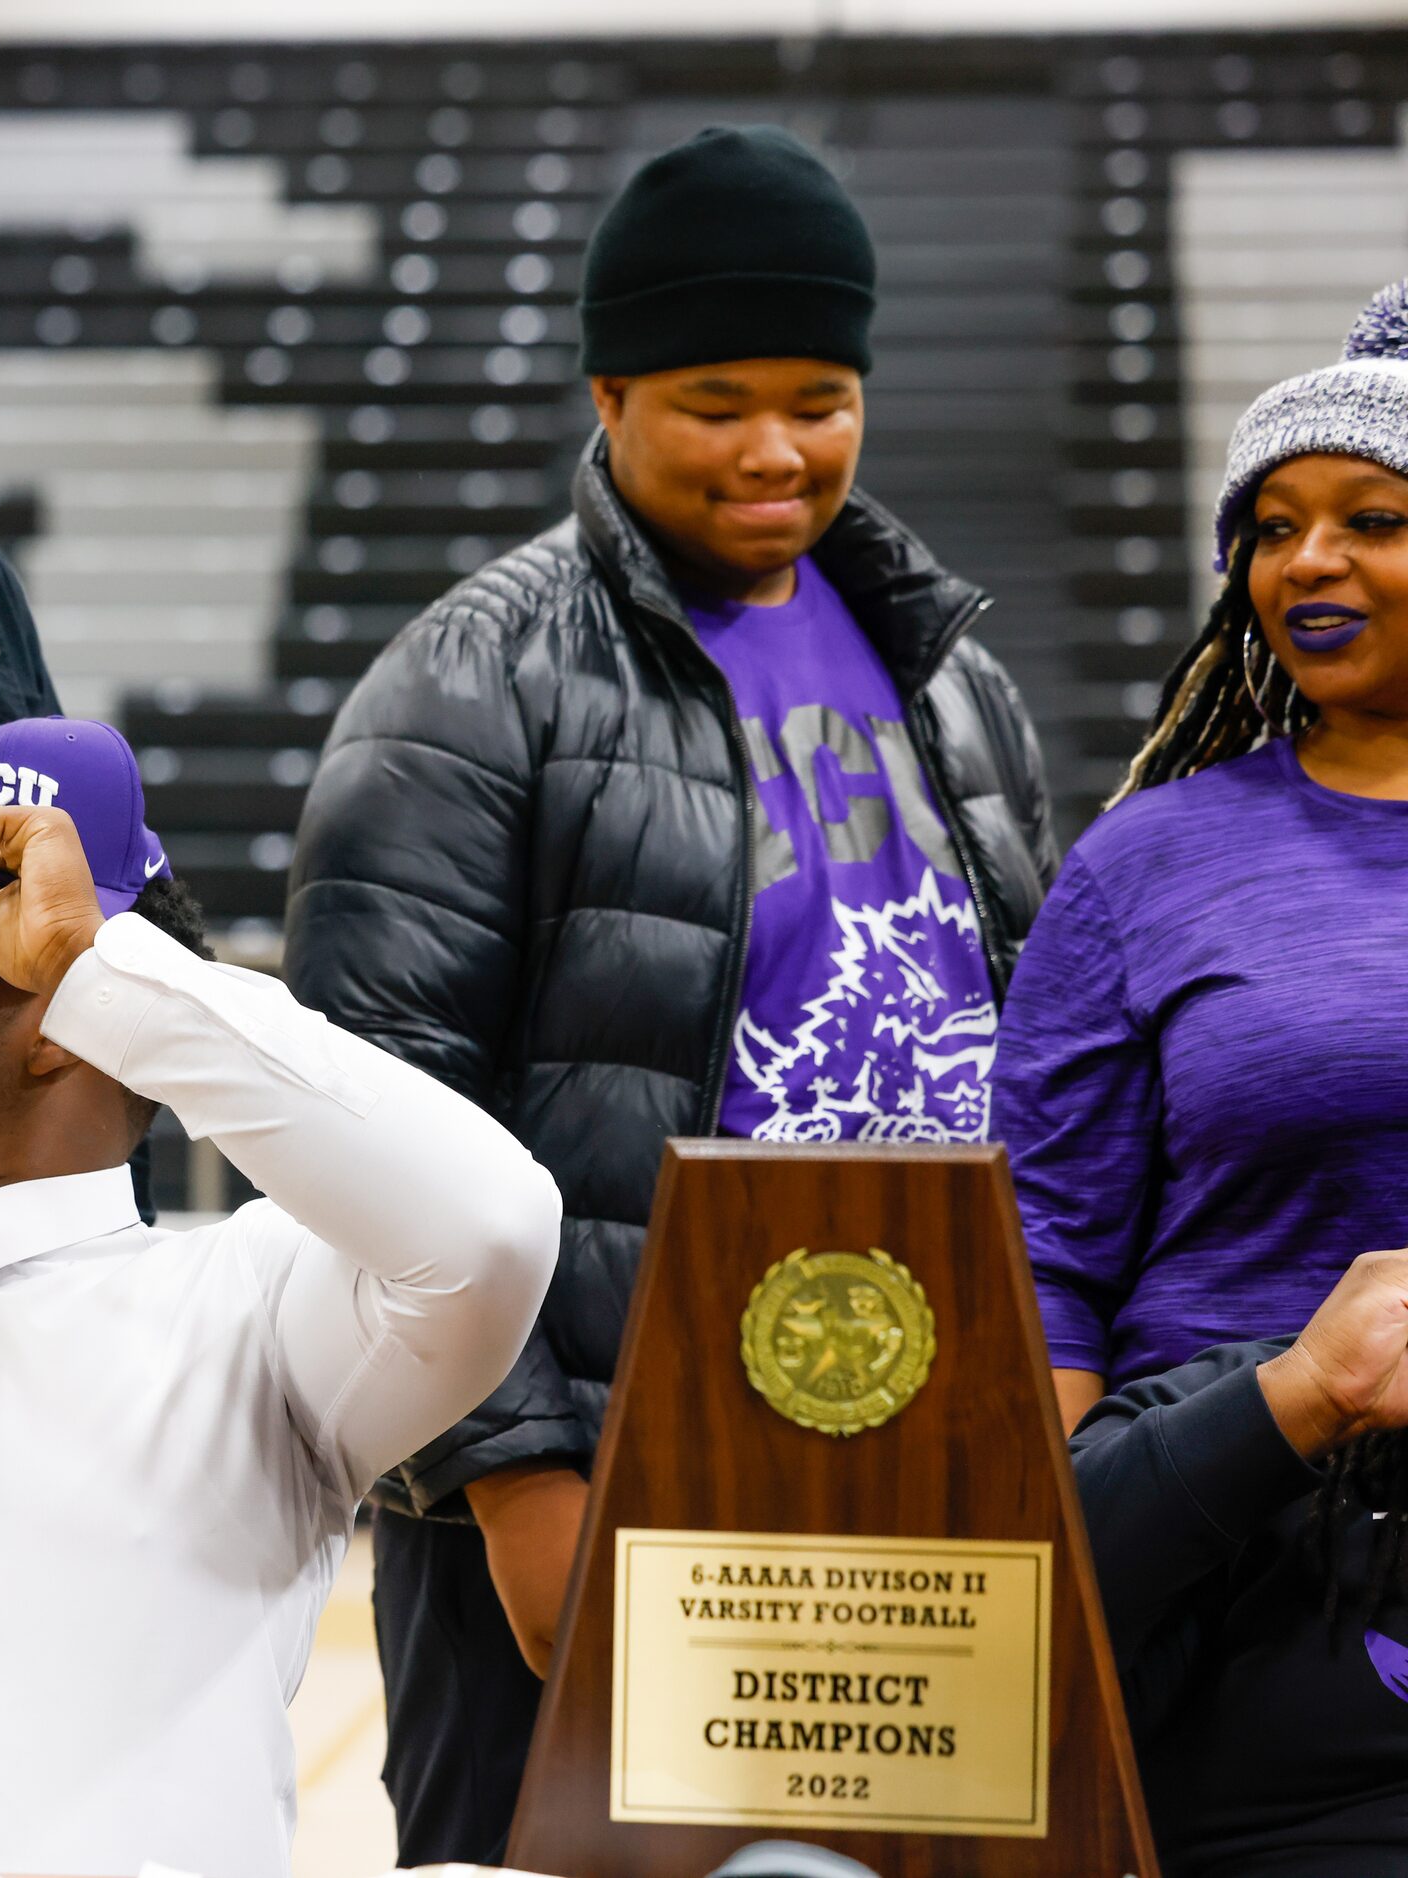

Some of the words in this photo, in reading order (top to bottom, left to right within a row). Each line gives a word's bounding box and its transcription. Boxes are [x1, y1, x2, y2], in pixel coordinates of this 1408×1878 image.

[691, 1565, 814, 1589] 6-AAAAA
[825, 1570, 953, 1592] DIVISON
[963, 1572, 987, 1594] II
[680, 1599, 803, 1622] VARSITY
[813, 1602, 976, 1629] FOOTBALL
[733, 1670, 929, 1706] DISTRICT
[704, 1720, 956, 1757] CHAMPIONS
[786, 1775, 871, 1799] 2022
